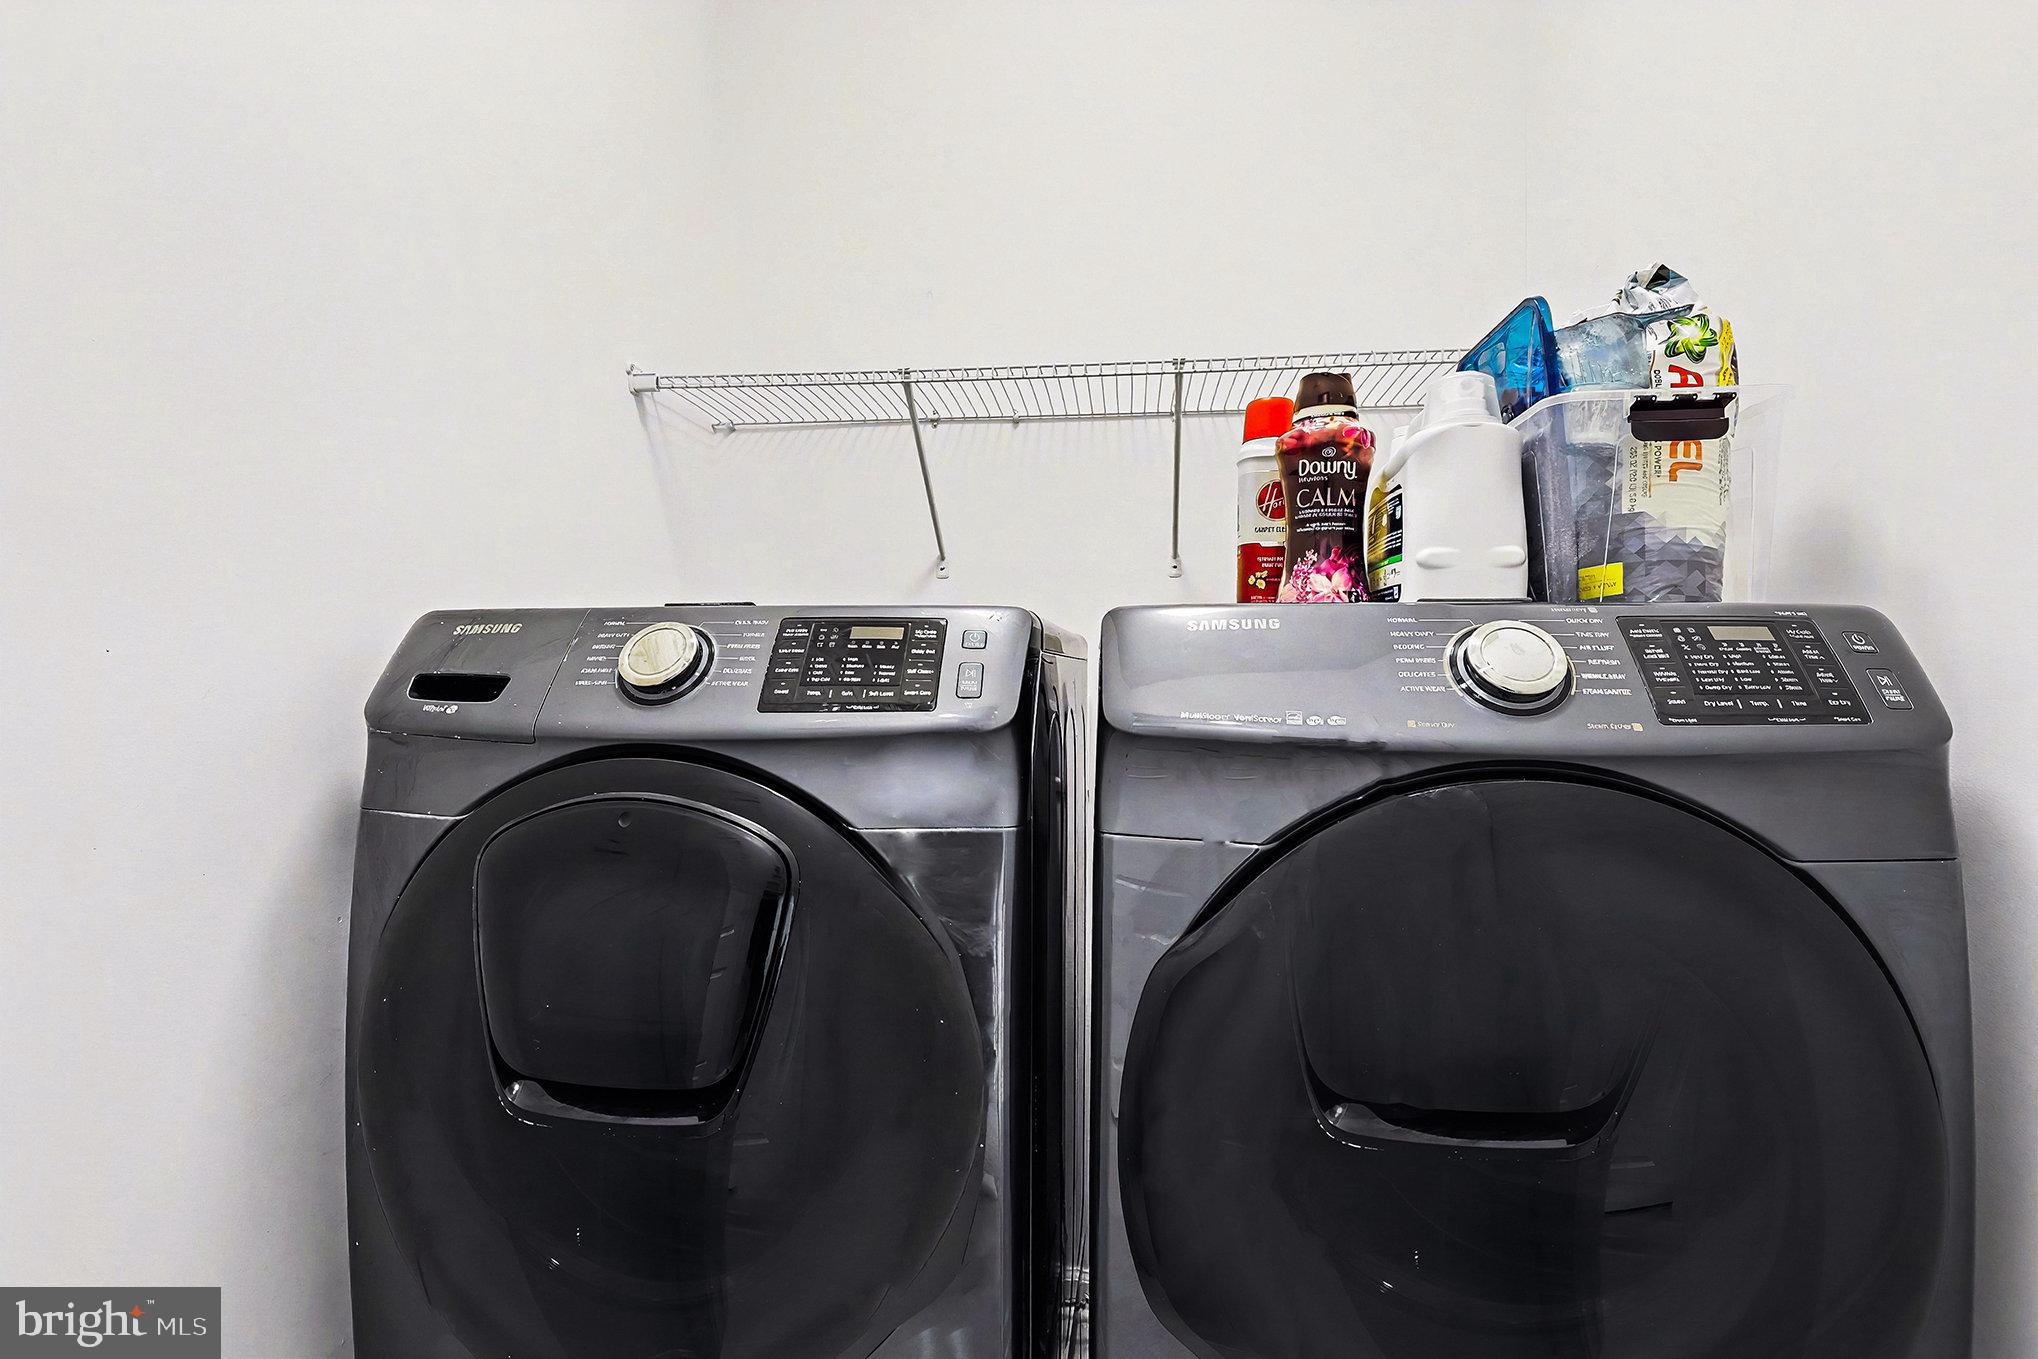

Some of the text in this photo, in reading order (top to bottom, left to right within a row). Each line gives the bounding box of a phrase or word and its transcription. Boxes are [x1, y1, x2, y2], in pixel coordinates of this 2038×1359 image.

[1298, 459, 1355, 480] Downy
[1296, 488, 1356, 508] CALM
[453, 623, 523, 636] SAMSUNG
[1186, 618, 1281, 632] SAMSUNG
